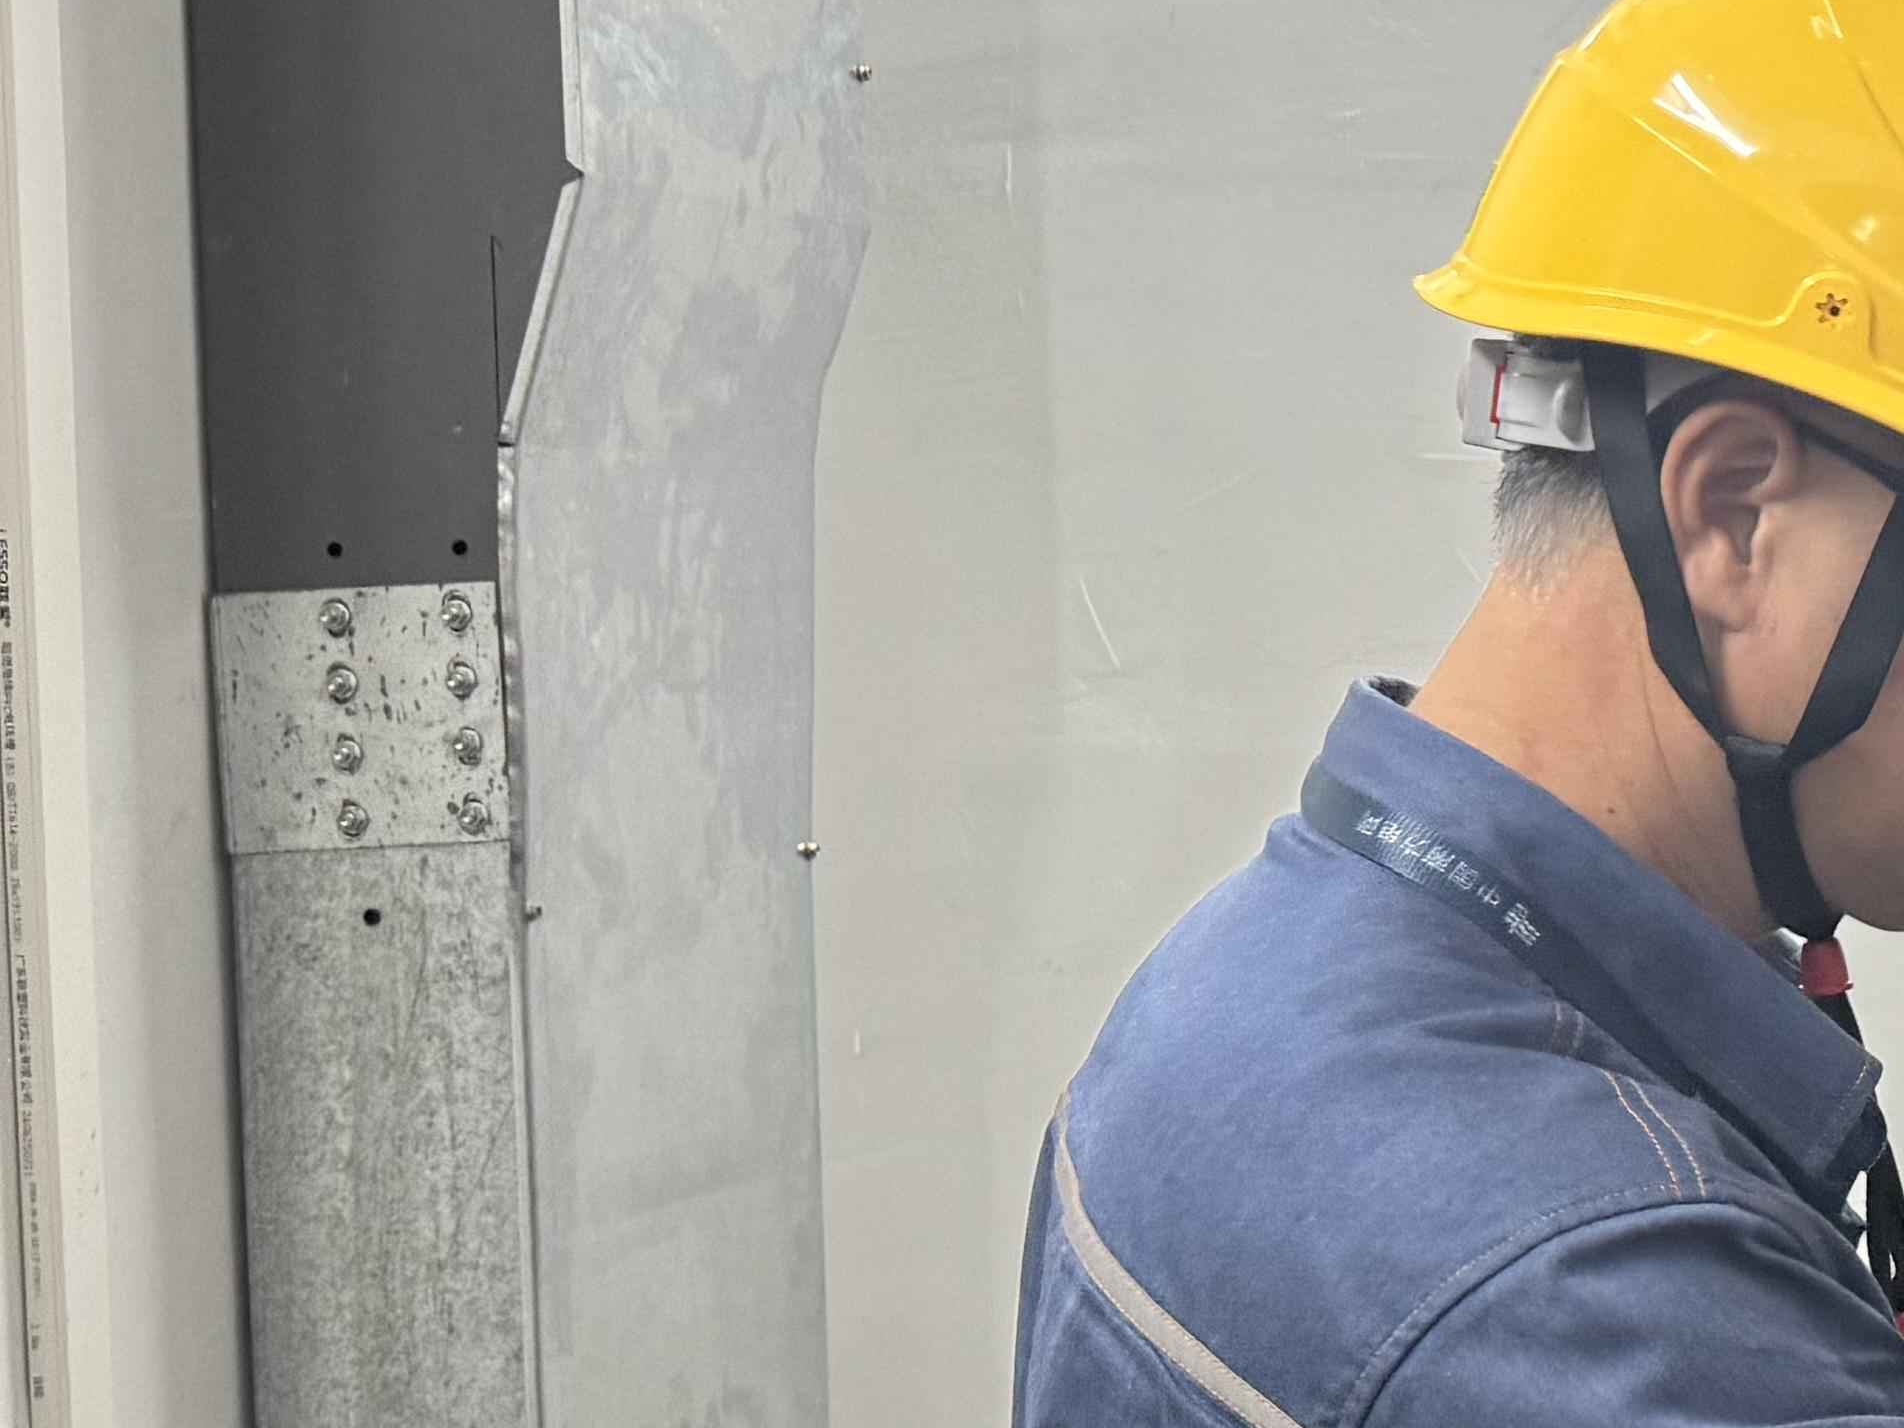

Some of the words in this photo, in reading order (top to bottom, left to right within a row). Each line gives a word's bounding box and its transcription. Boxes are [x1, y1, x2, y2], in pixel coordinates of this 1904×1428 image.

[1354, 812, 1501, 907] 中国南方电网
